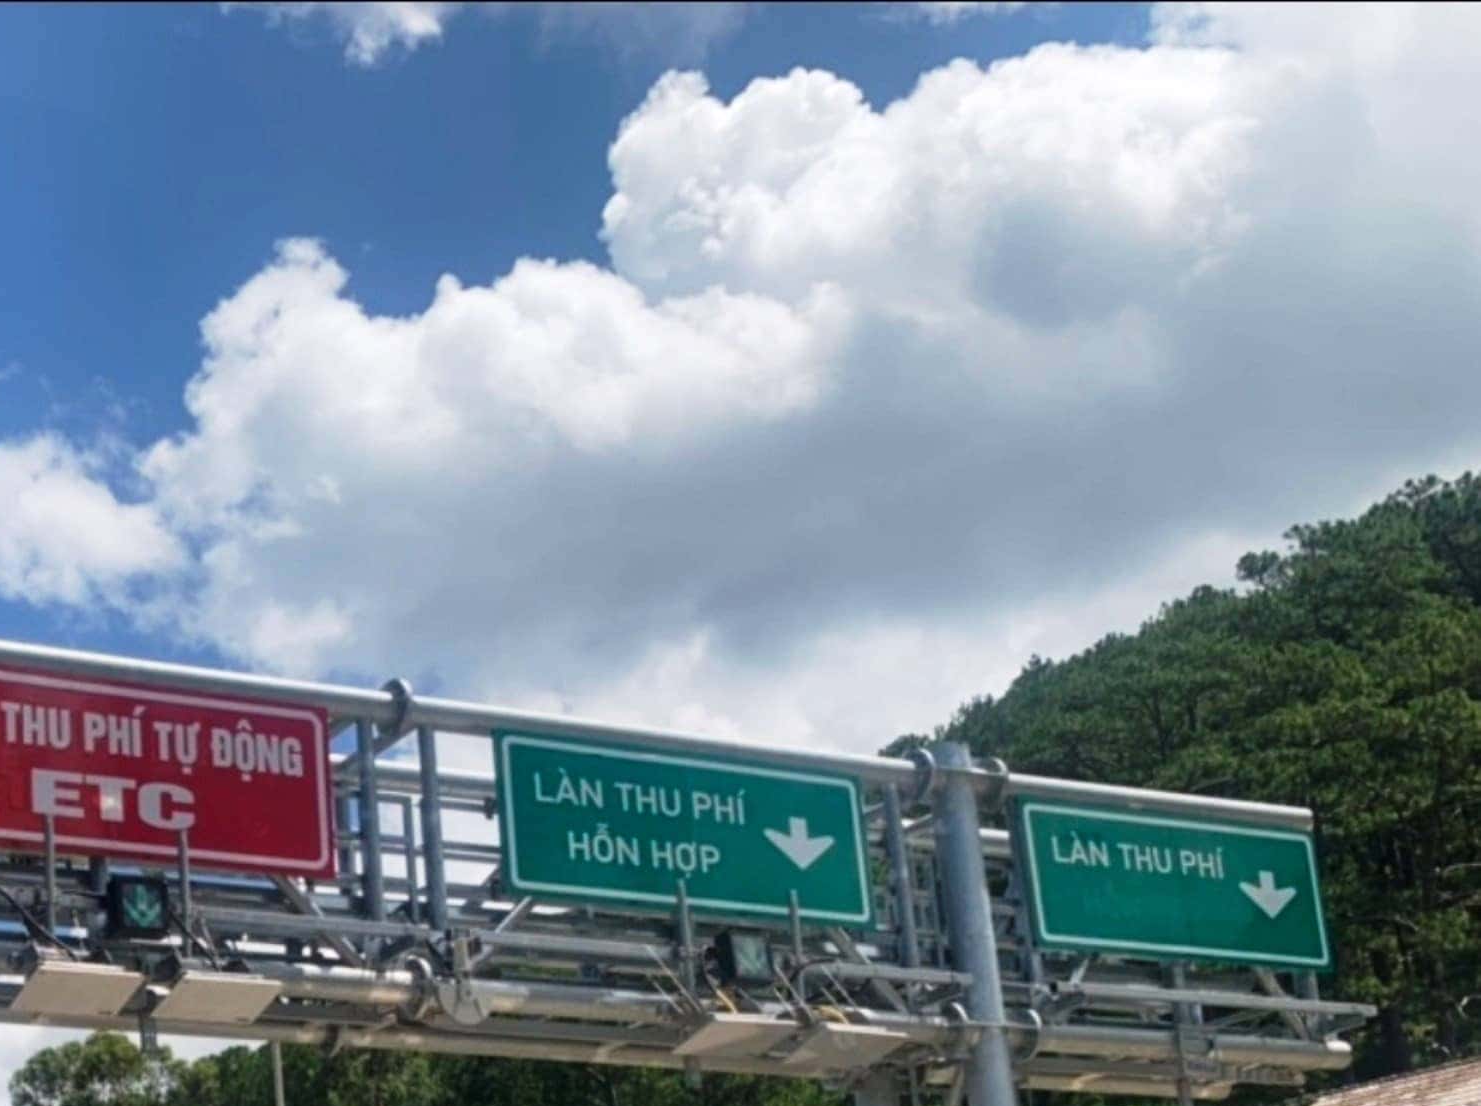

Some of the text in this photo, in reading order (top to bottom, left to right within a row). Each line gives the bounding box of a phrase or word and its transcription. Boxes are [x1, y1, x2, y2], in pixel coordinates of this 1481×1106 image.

[0, 702, 72, 750] THU
[84, 706, 144, 758] PHÍ
[153, 720, 201, 775] TỰ
[211, 720, 304, 781] ĐỘNG
[30, 767, 196, 830] ETC
[533, 768, 747, 825] LÀN THU PHÍ
[567, 823, 720, 878] HỖN HỢP
[1051, 830, 1224, 879] LÀN THU PHÍ
